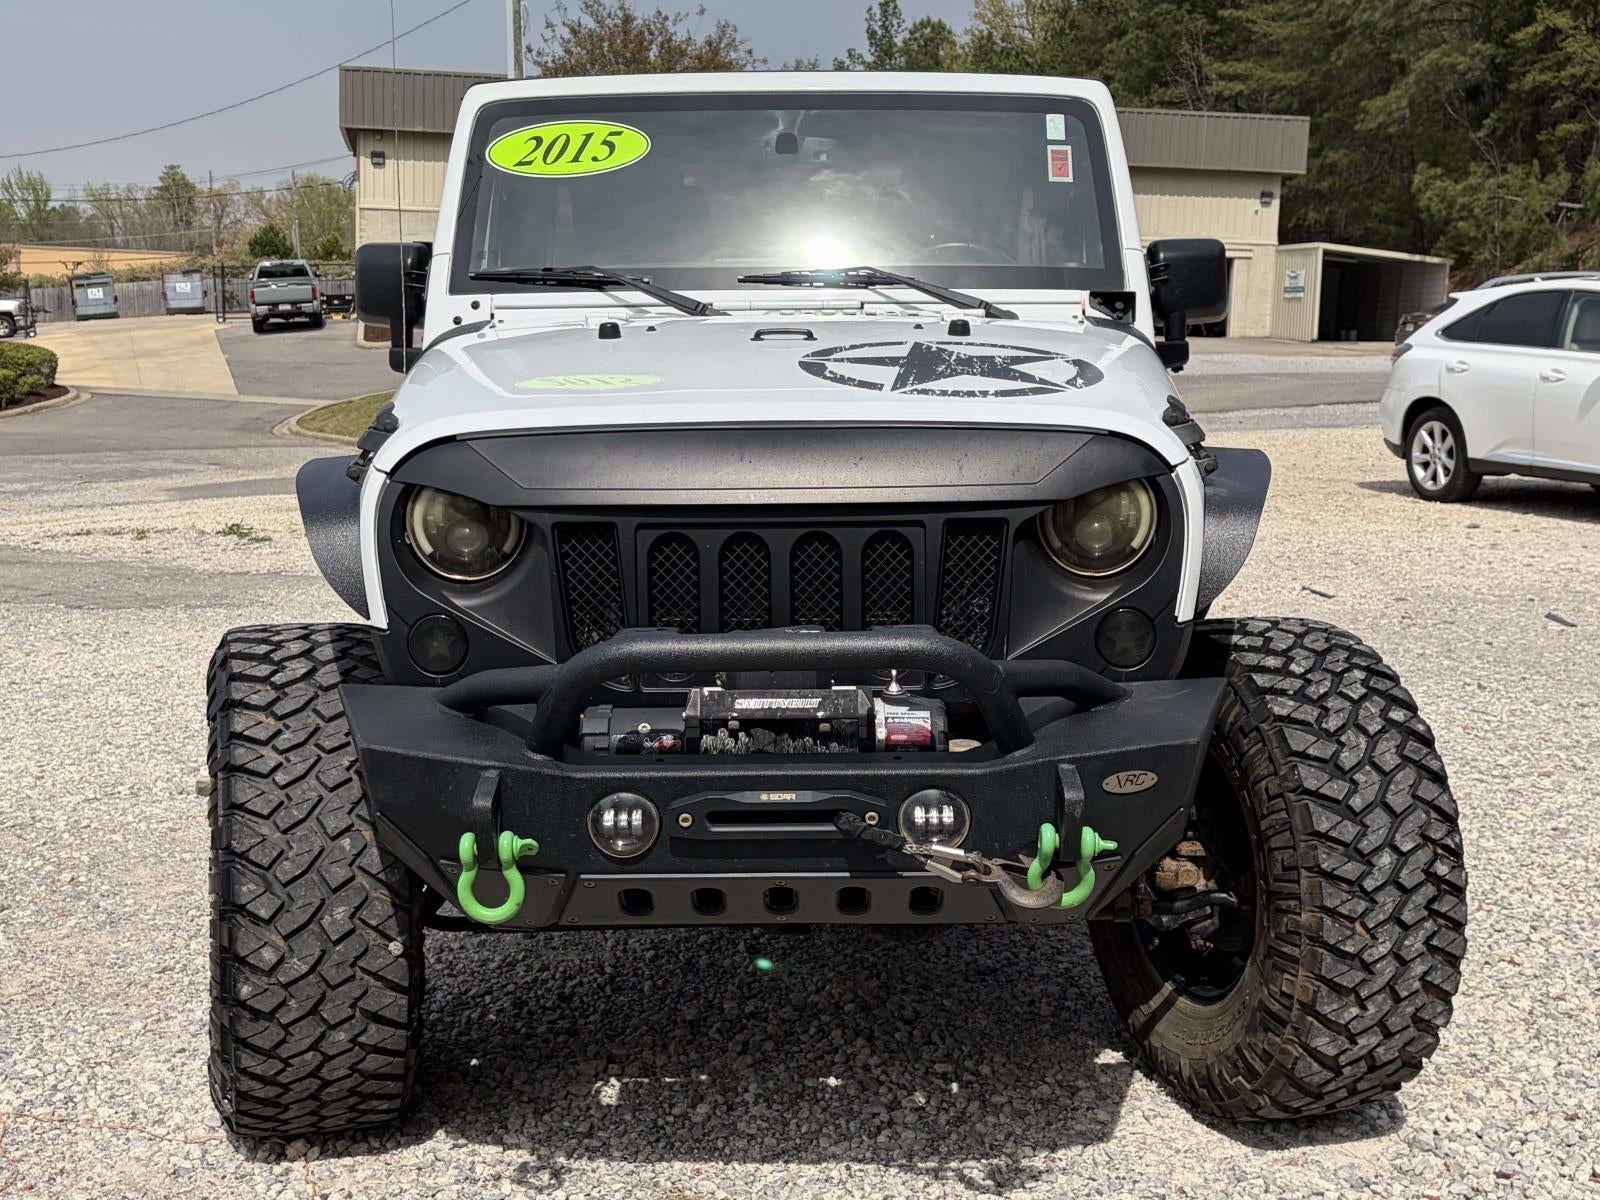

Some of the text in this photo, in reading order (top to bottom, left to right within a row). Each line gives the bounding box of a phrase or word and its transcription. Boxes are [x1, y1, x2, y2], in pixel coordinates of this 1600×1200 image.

[513, 131, 624, 167] 2015
[734, 698, 822, 709] SMITTYBILT
[1111, 772, 1148, 790] XRC
[769, 793, 796, 801] SOAR
